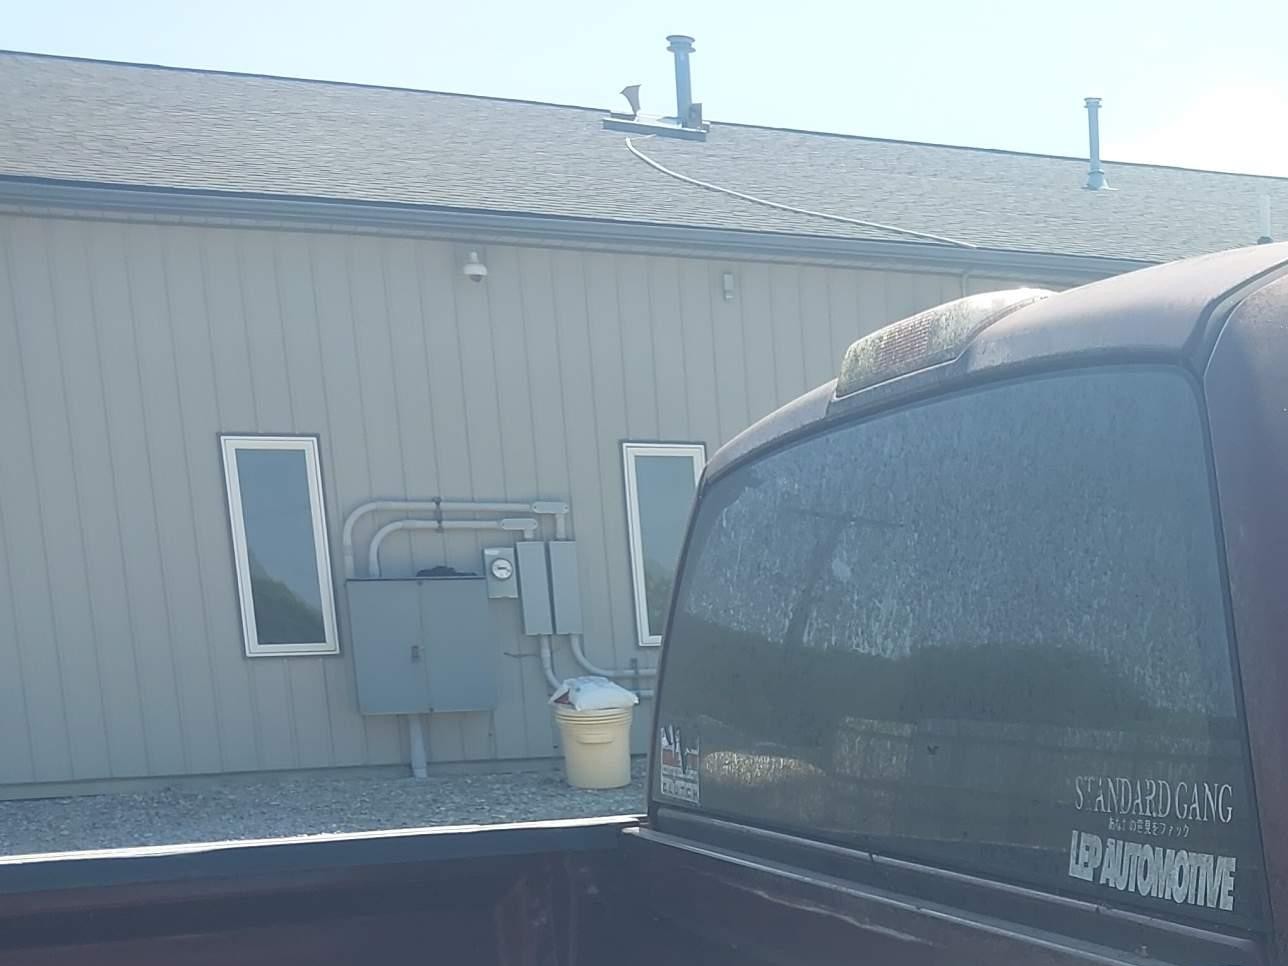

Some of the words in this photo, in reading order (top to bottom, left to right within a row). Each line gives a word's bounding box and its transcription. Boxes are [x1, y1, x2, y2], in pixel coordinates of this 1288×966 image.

[1076, 777, 1171, 818] STANDARD
[1175, 783, 1232, 823] GANG
[1069, 830, 1102, 881] LEP
